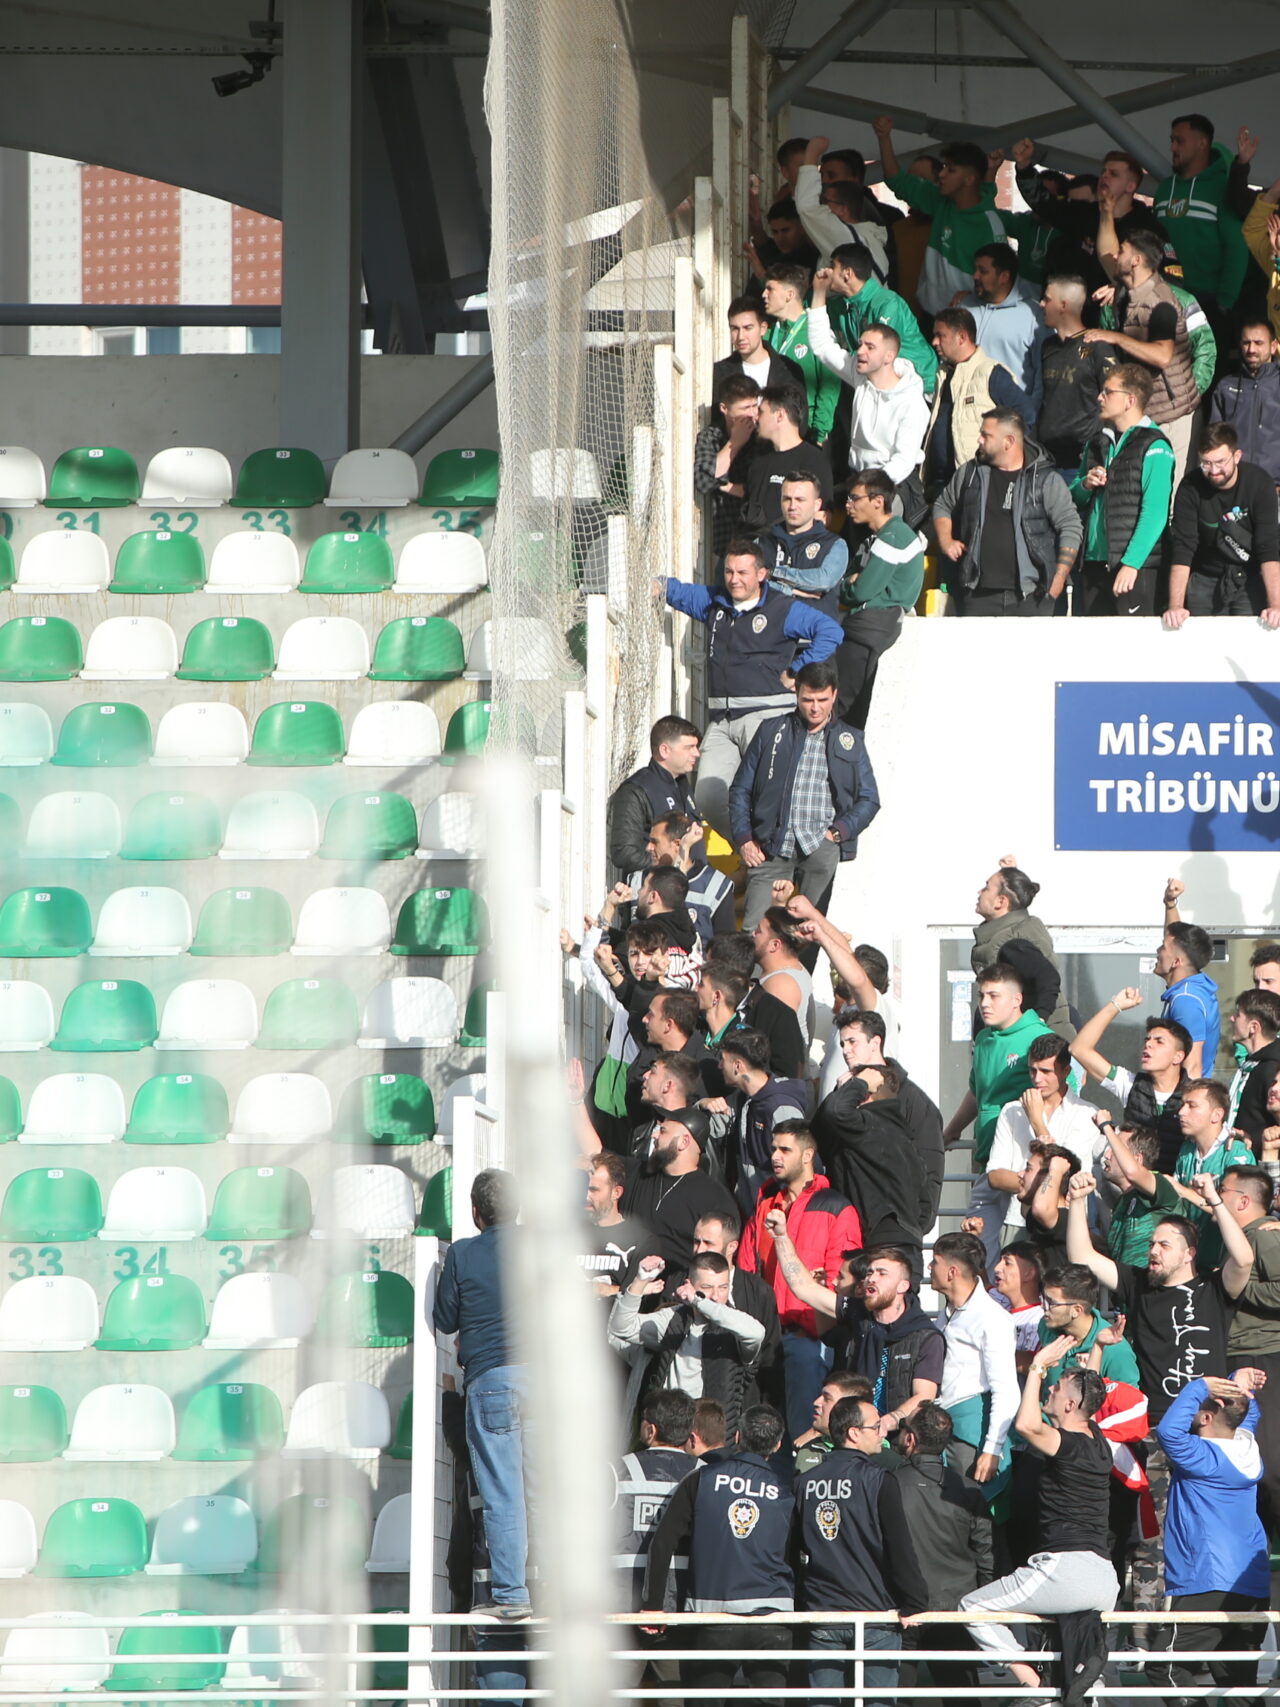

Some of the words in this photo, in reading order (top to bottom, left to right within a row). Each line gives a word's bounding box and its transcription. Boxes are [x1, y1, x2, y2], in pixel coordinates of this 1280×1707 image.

[150, 511, 199, 539] 32
[242, 510, 291, 536] 33
[340, 511, 389, 541] 34
[432, 511, 481, 538] 35
[1224, 535, 1251, 562] adidas
[1099, 714, 1274, 756] MİSAFİR
[1089, 771, 1280, 813] TRİBÜNÜ
[8, 1246, 64, 1281] 33
[114, 1246, 170, 1280] 34
[714, 1474, 779, 1500] POLIS
[805, 1479, 852, 1500] POLIS
